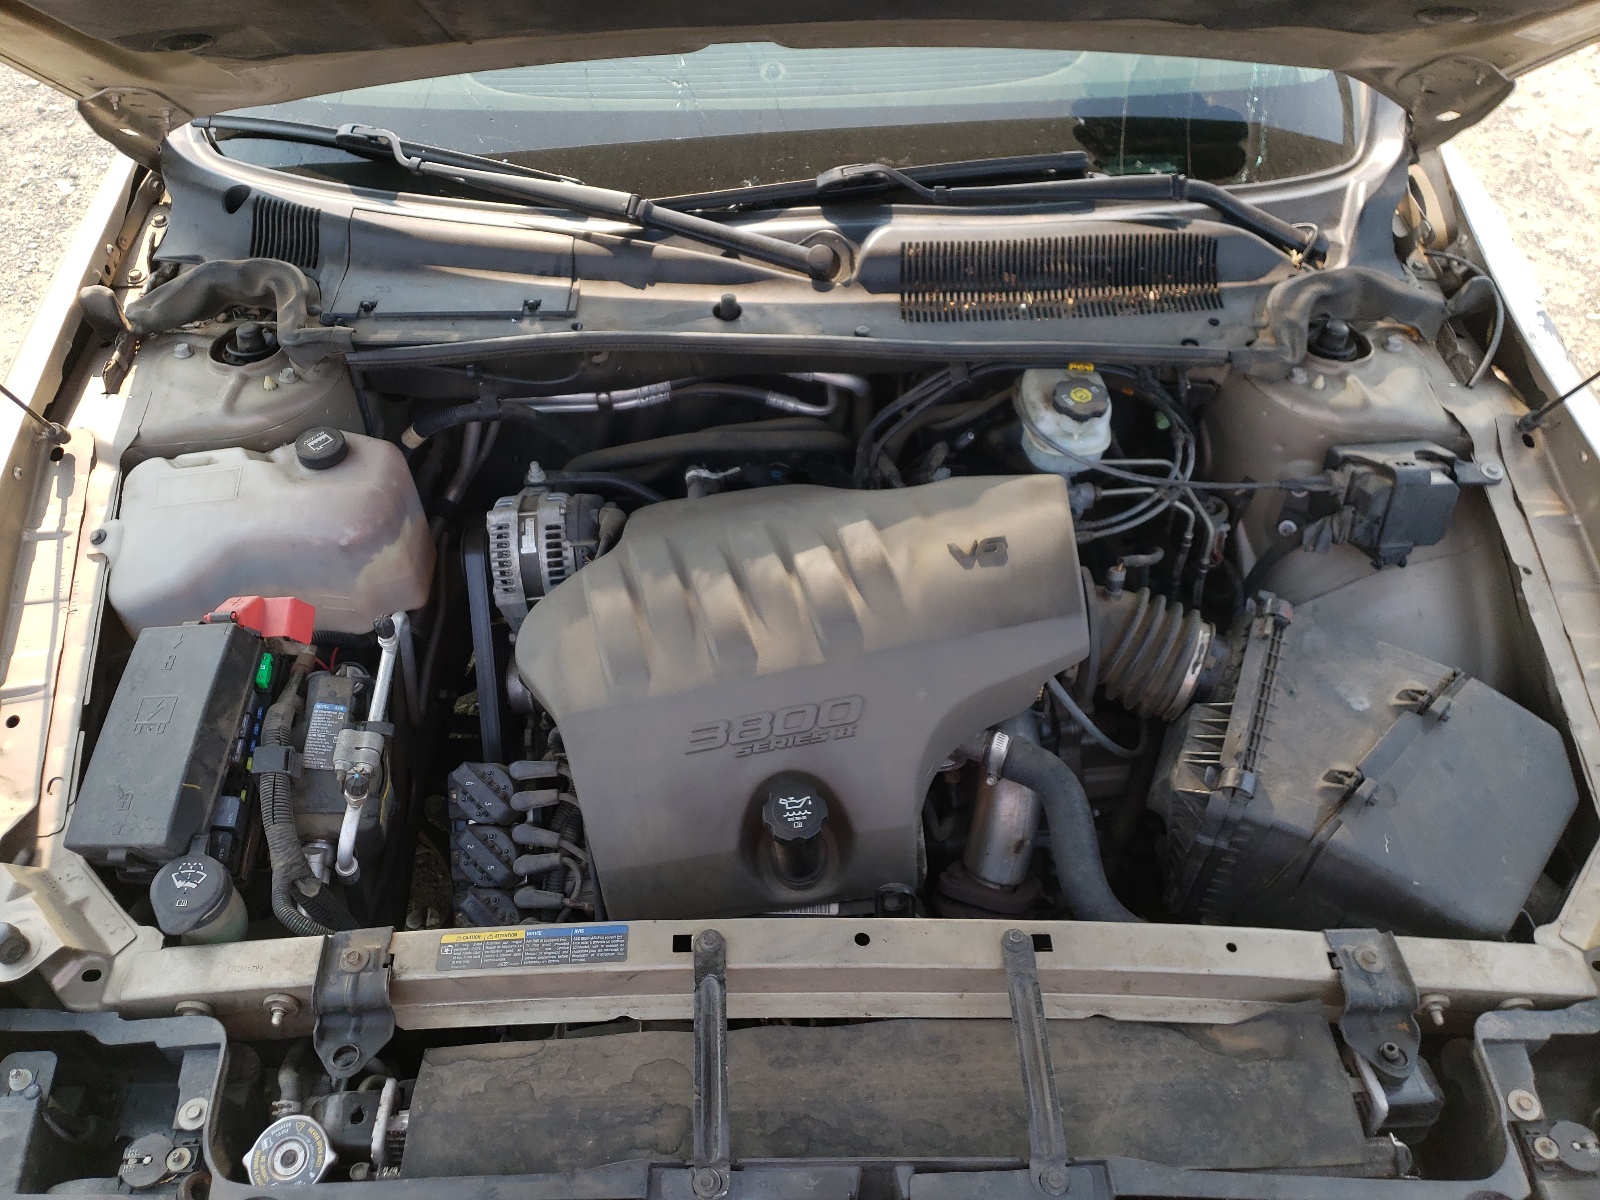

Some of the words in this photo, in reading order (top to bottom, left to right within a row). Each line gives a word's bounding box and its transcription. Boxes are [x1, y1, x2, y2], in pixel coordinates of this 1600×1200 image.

[946, 535, 1009, 570] V6
[684, 694, 866, 756] 3800
[734, 730, 830, 759] SERIES
